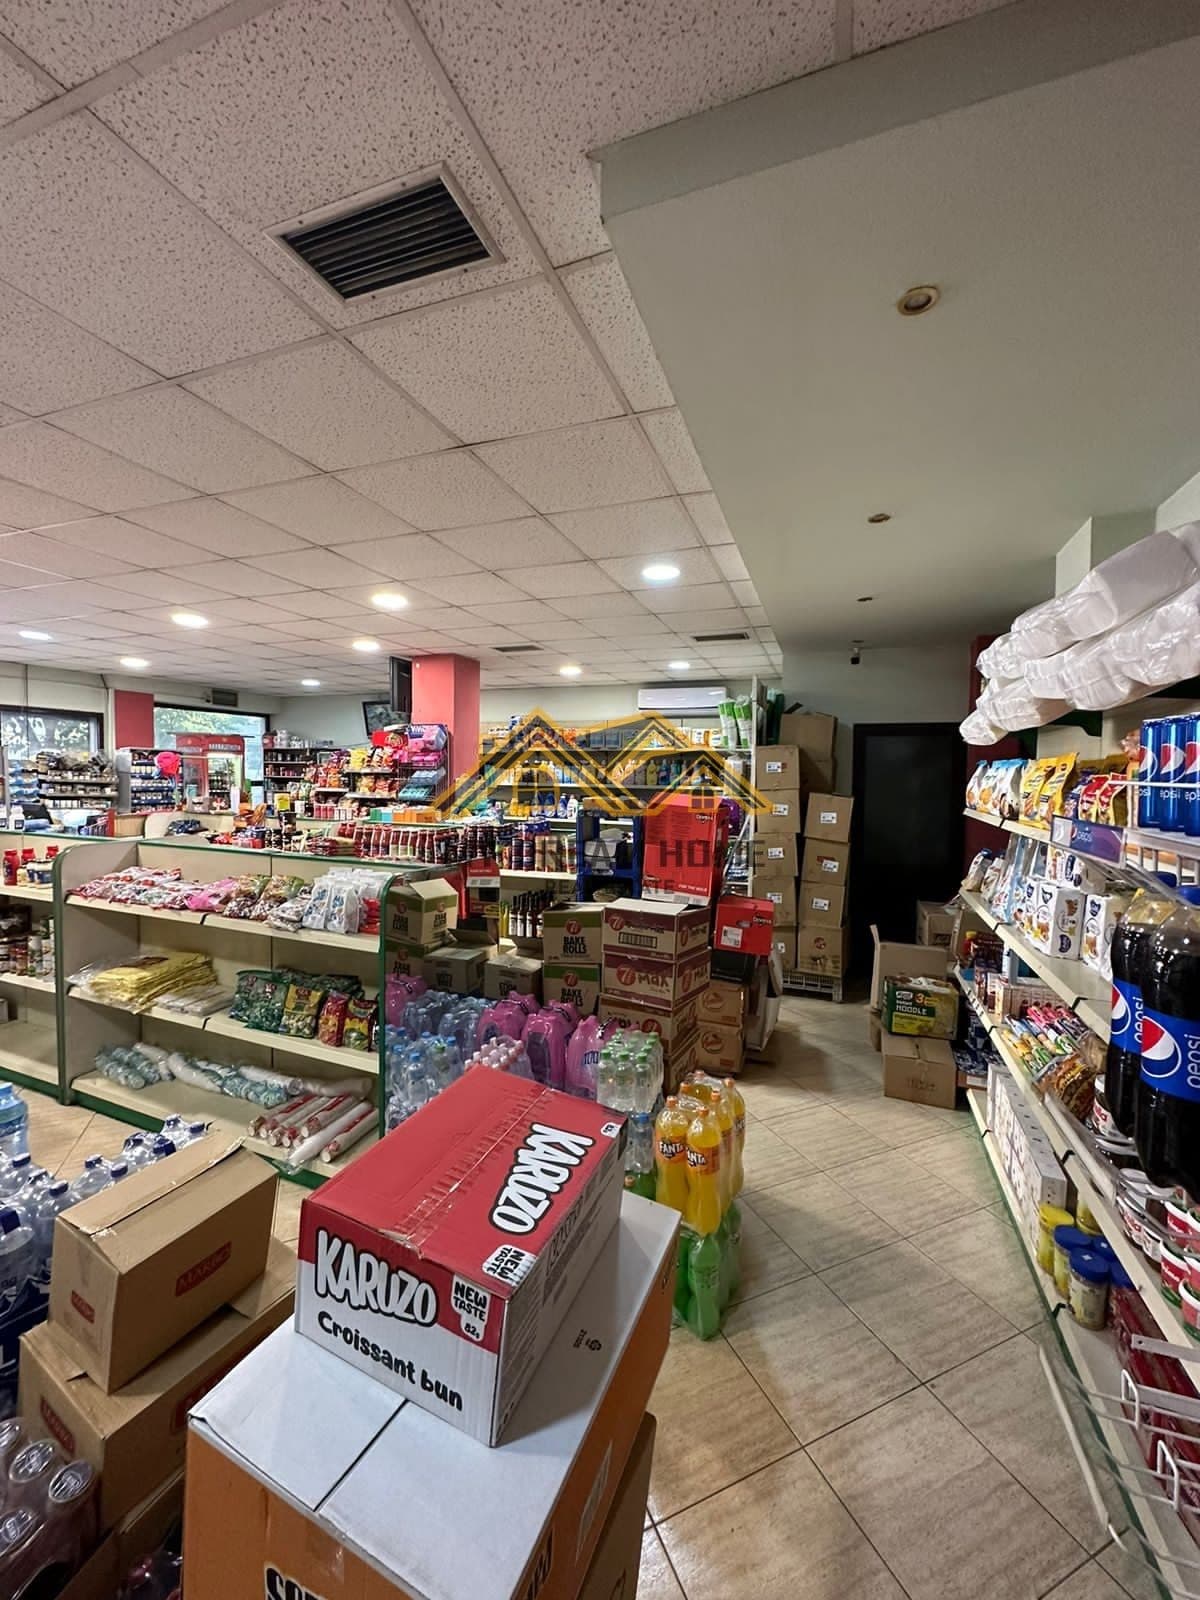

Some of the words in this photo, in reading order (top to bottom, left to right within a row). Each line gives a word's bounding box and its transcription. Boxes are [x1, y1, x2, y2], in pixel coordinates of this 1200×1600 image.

[563, 936, 585, 944] BAKE
[563, 944, 587, 954] ROLLS
[491, 1121, 595, 1235] KARUZO
[487, 1247, 512, 1274] TASTE
[497, 1250, 525, 1280] NEW
[316, 1228, 438, 1327] KARUZO
[453, 1295, 486, 1322] TASTE
[454, 1281, 487, 1309] NEW
[318, 1311, 416, 1385] Croissant
[420, 1369, 463, 1412] bun
